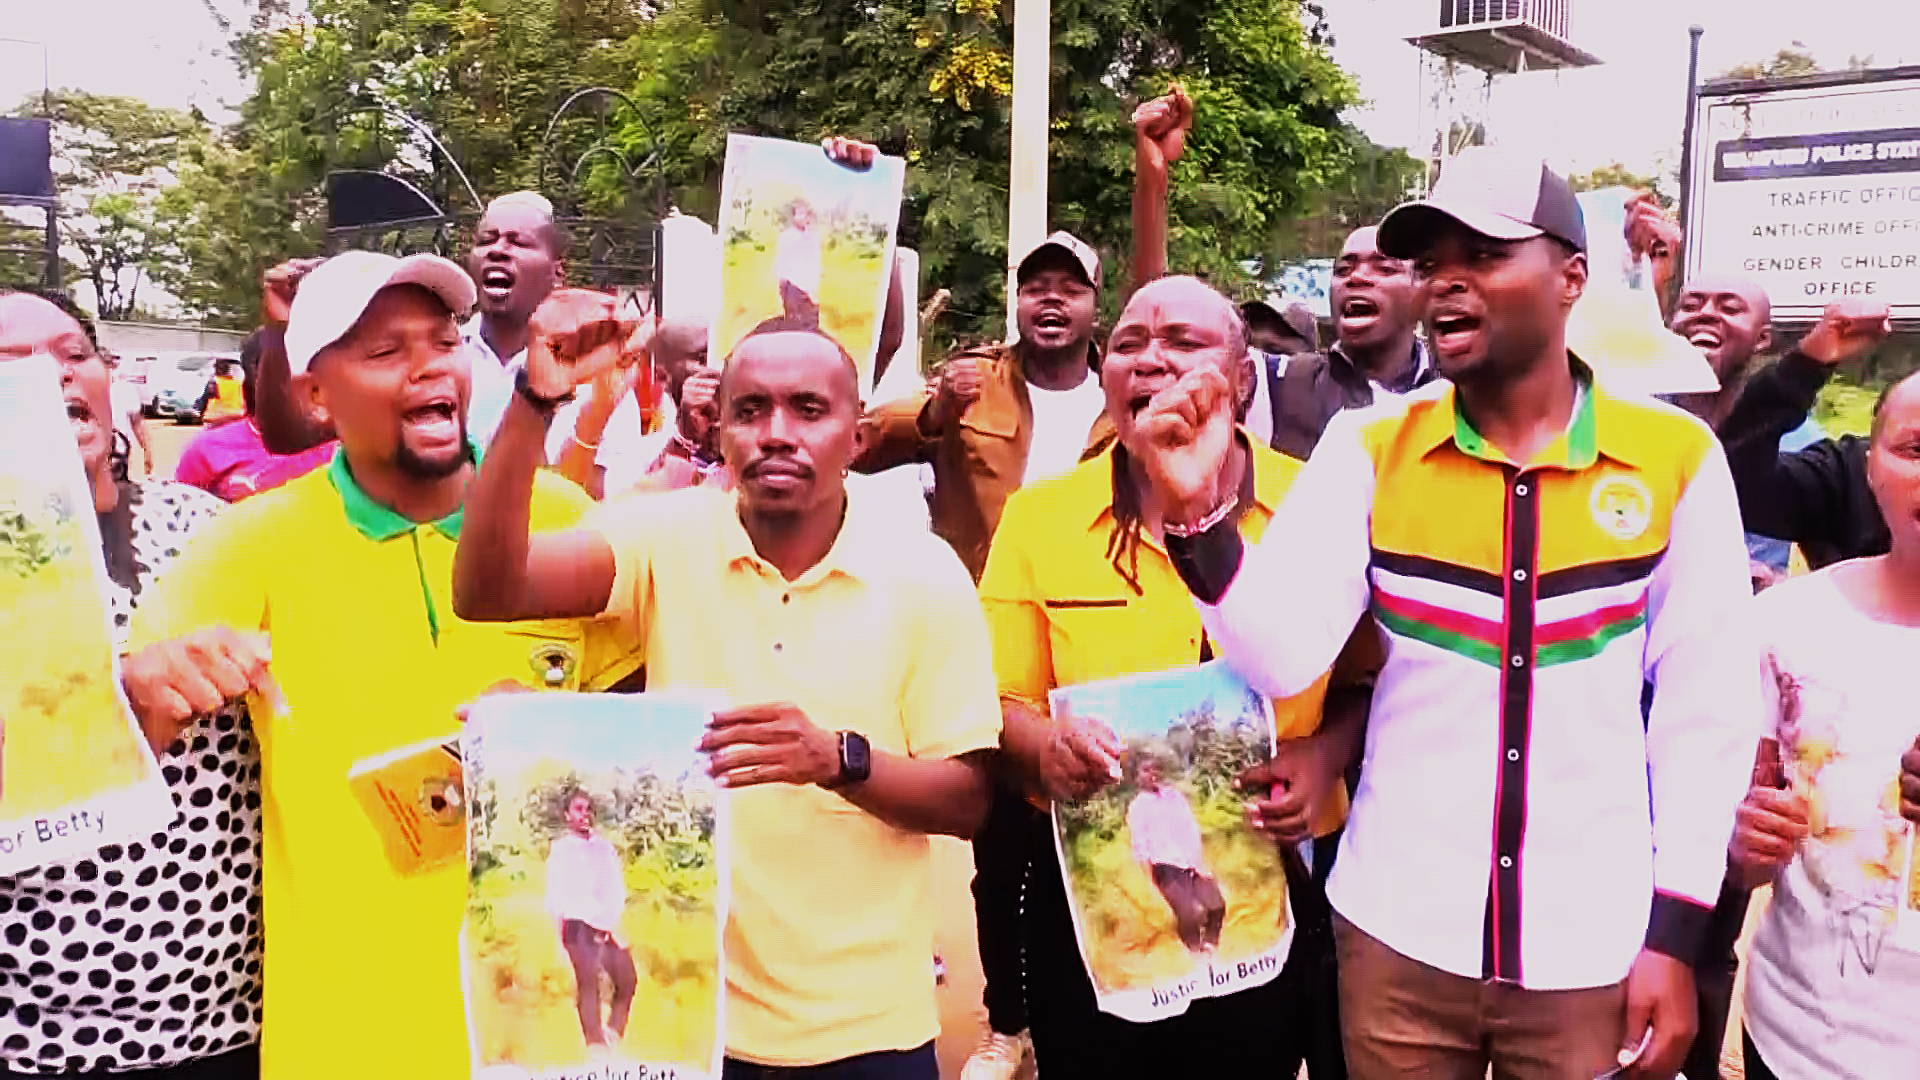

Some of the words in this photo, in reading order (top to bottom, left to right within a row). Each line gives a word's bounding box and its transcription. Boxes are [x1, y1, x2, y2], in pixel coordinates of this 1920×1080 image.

[1812, 143, 1873, 163] POLICE
[1768, 189, 1851, 207] TRAFFIC
[1752, 221, 1866, 237] ANTI-CRIME
[1744, 256, 1822, 271] GENDER
[1841, 255, 1920, 269] CHILDR
[1804, 281, 1876, 295] OFFICE
[35, 810, 104, 843] Betty
[1237, 954, 1277, 979] Betty
